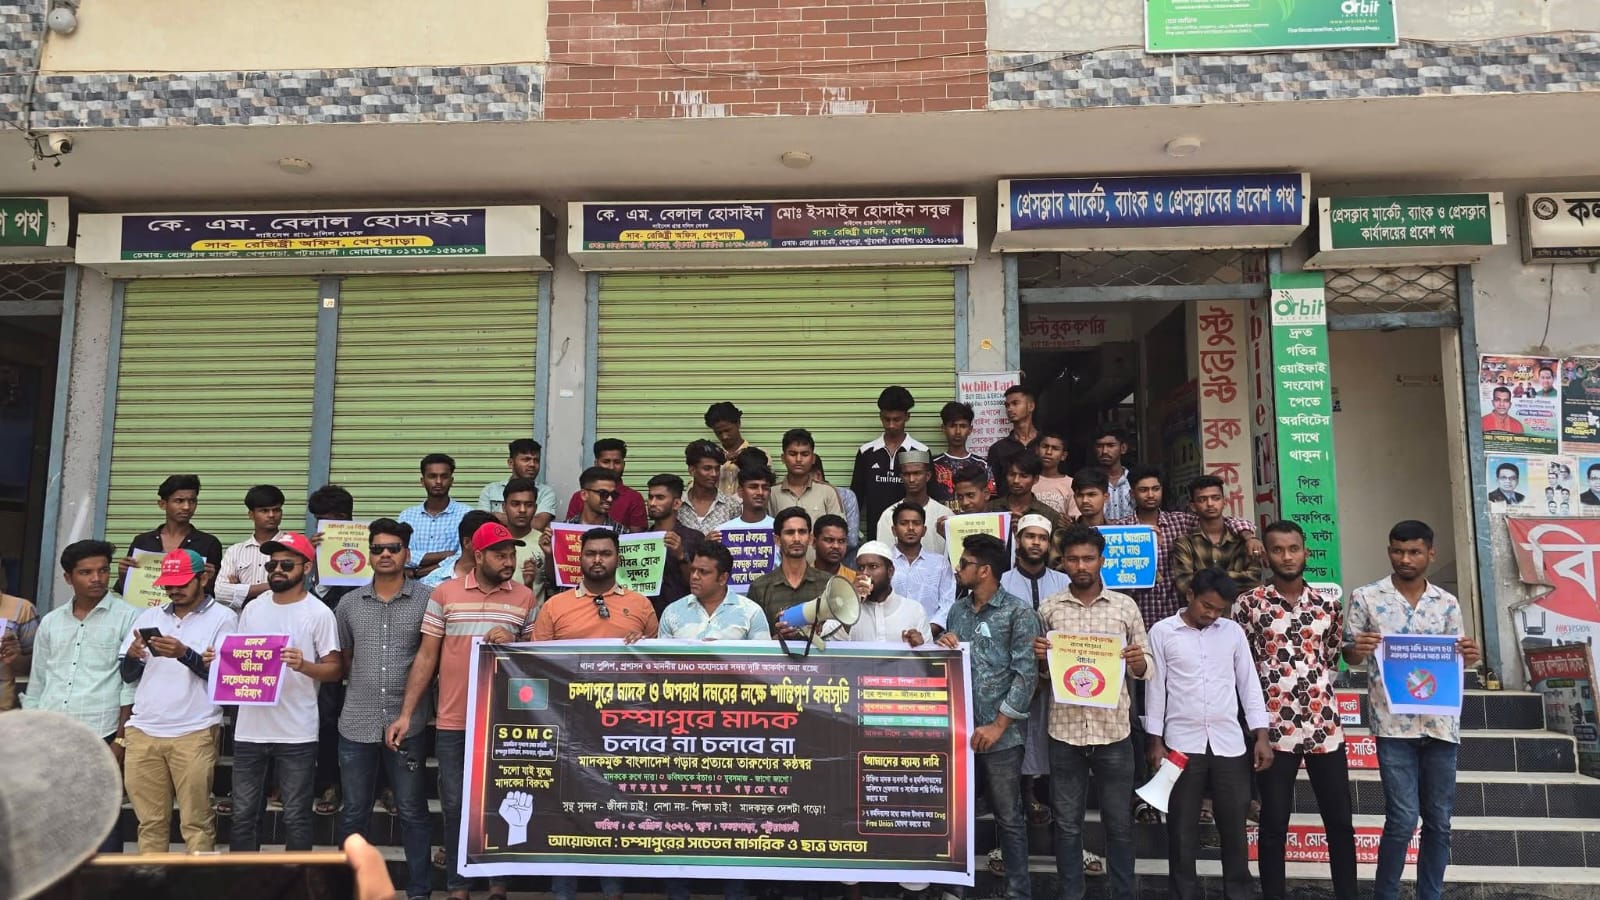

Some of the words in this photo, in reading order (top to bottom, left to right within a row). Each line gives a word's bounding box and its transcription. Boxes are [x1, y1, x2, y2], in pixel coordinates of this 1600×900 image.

[1113, 190, 1148, 217] ব্যাংক
[1152, 193, 1163, 212] ও
[1236, 186, 1272, 216] প্রবেশ
[1276, 186, 1297, 214] পথ
[660, 206, 702, 221] বেলাল
[708, 204, 764, 221] হোসাইন
[776, 205, 802, 221] মোঃ
[806, 203, 859, 220] ইসমাইল
[863, 201, 915, 219] হোসাইন
[919, 202, 951, 219] সবুজ
[1407, 204, 1433, 221] ব্যাংক
[1437, 207, 1446, 220] ও
[14, 208, 44, 238] পথ
[270, 214, 352, 231] বেলাল
[363, 210, 472, 229] হোসাইন
[1409, 224, 1437, 240] প্রবেশ
[1439, 224, 1456, 240] পথ
[1274, 297, 1325, 316] Orbit
[875, 474, 905, 484] Emirate
[678, 663, 695, 671] UNO
[617, 682, 646, 702] মাদক
[649, 683, 659, 703] ও
[599, 710, 716, 734] চম্পাপুরে
[721, 711, 799, 729] মাদক
[602, 735, 668, 752] চলবে
[671, 736, 697, 753] না
[701, 736, 766, 753] চলবে
[769, 738, 795, 754] না
[577, 755, 623, 770] মাদকমুক্ত
[625, 755, 671, 769] বাংলাদেশ
[673, 756, 699, 770] গড়ার
[606, 798, 628, 812] জীবন
[620, 836, 685, 853] চম্পাপুরের
[687, 836, 732, 850] সচেতন
[734, 835, 785, 851] নাগরিক
[787, 839, 798, 851] ও
[800, 839, 827, 853] ছাত্র
[828, 839, 868, 853] জনতা
